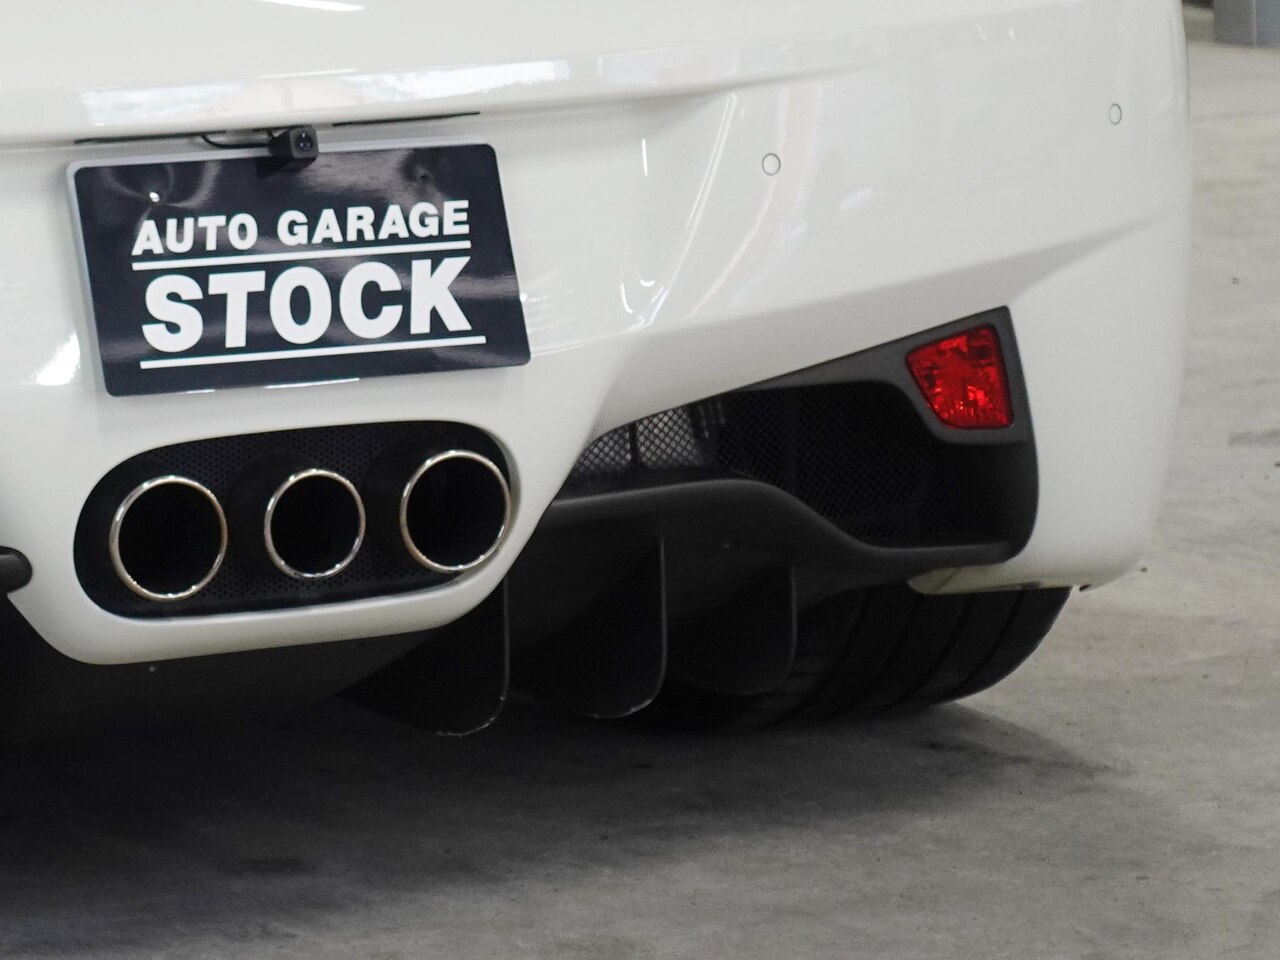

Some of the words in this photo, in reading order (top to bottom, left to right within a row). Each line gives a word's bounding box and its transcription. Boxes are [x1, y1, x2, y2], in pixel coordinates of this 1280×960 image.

[131, 213, 258, 256] AUTO
[277, 199, 470, 247] GARAGE
[141, 256, 472, 353] STOCK
